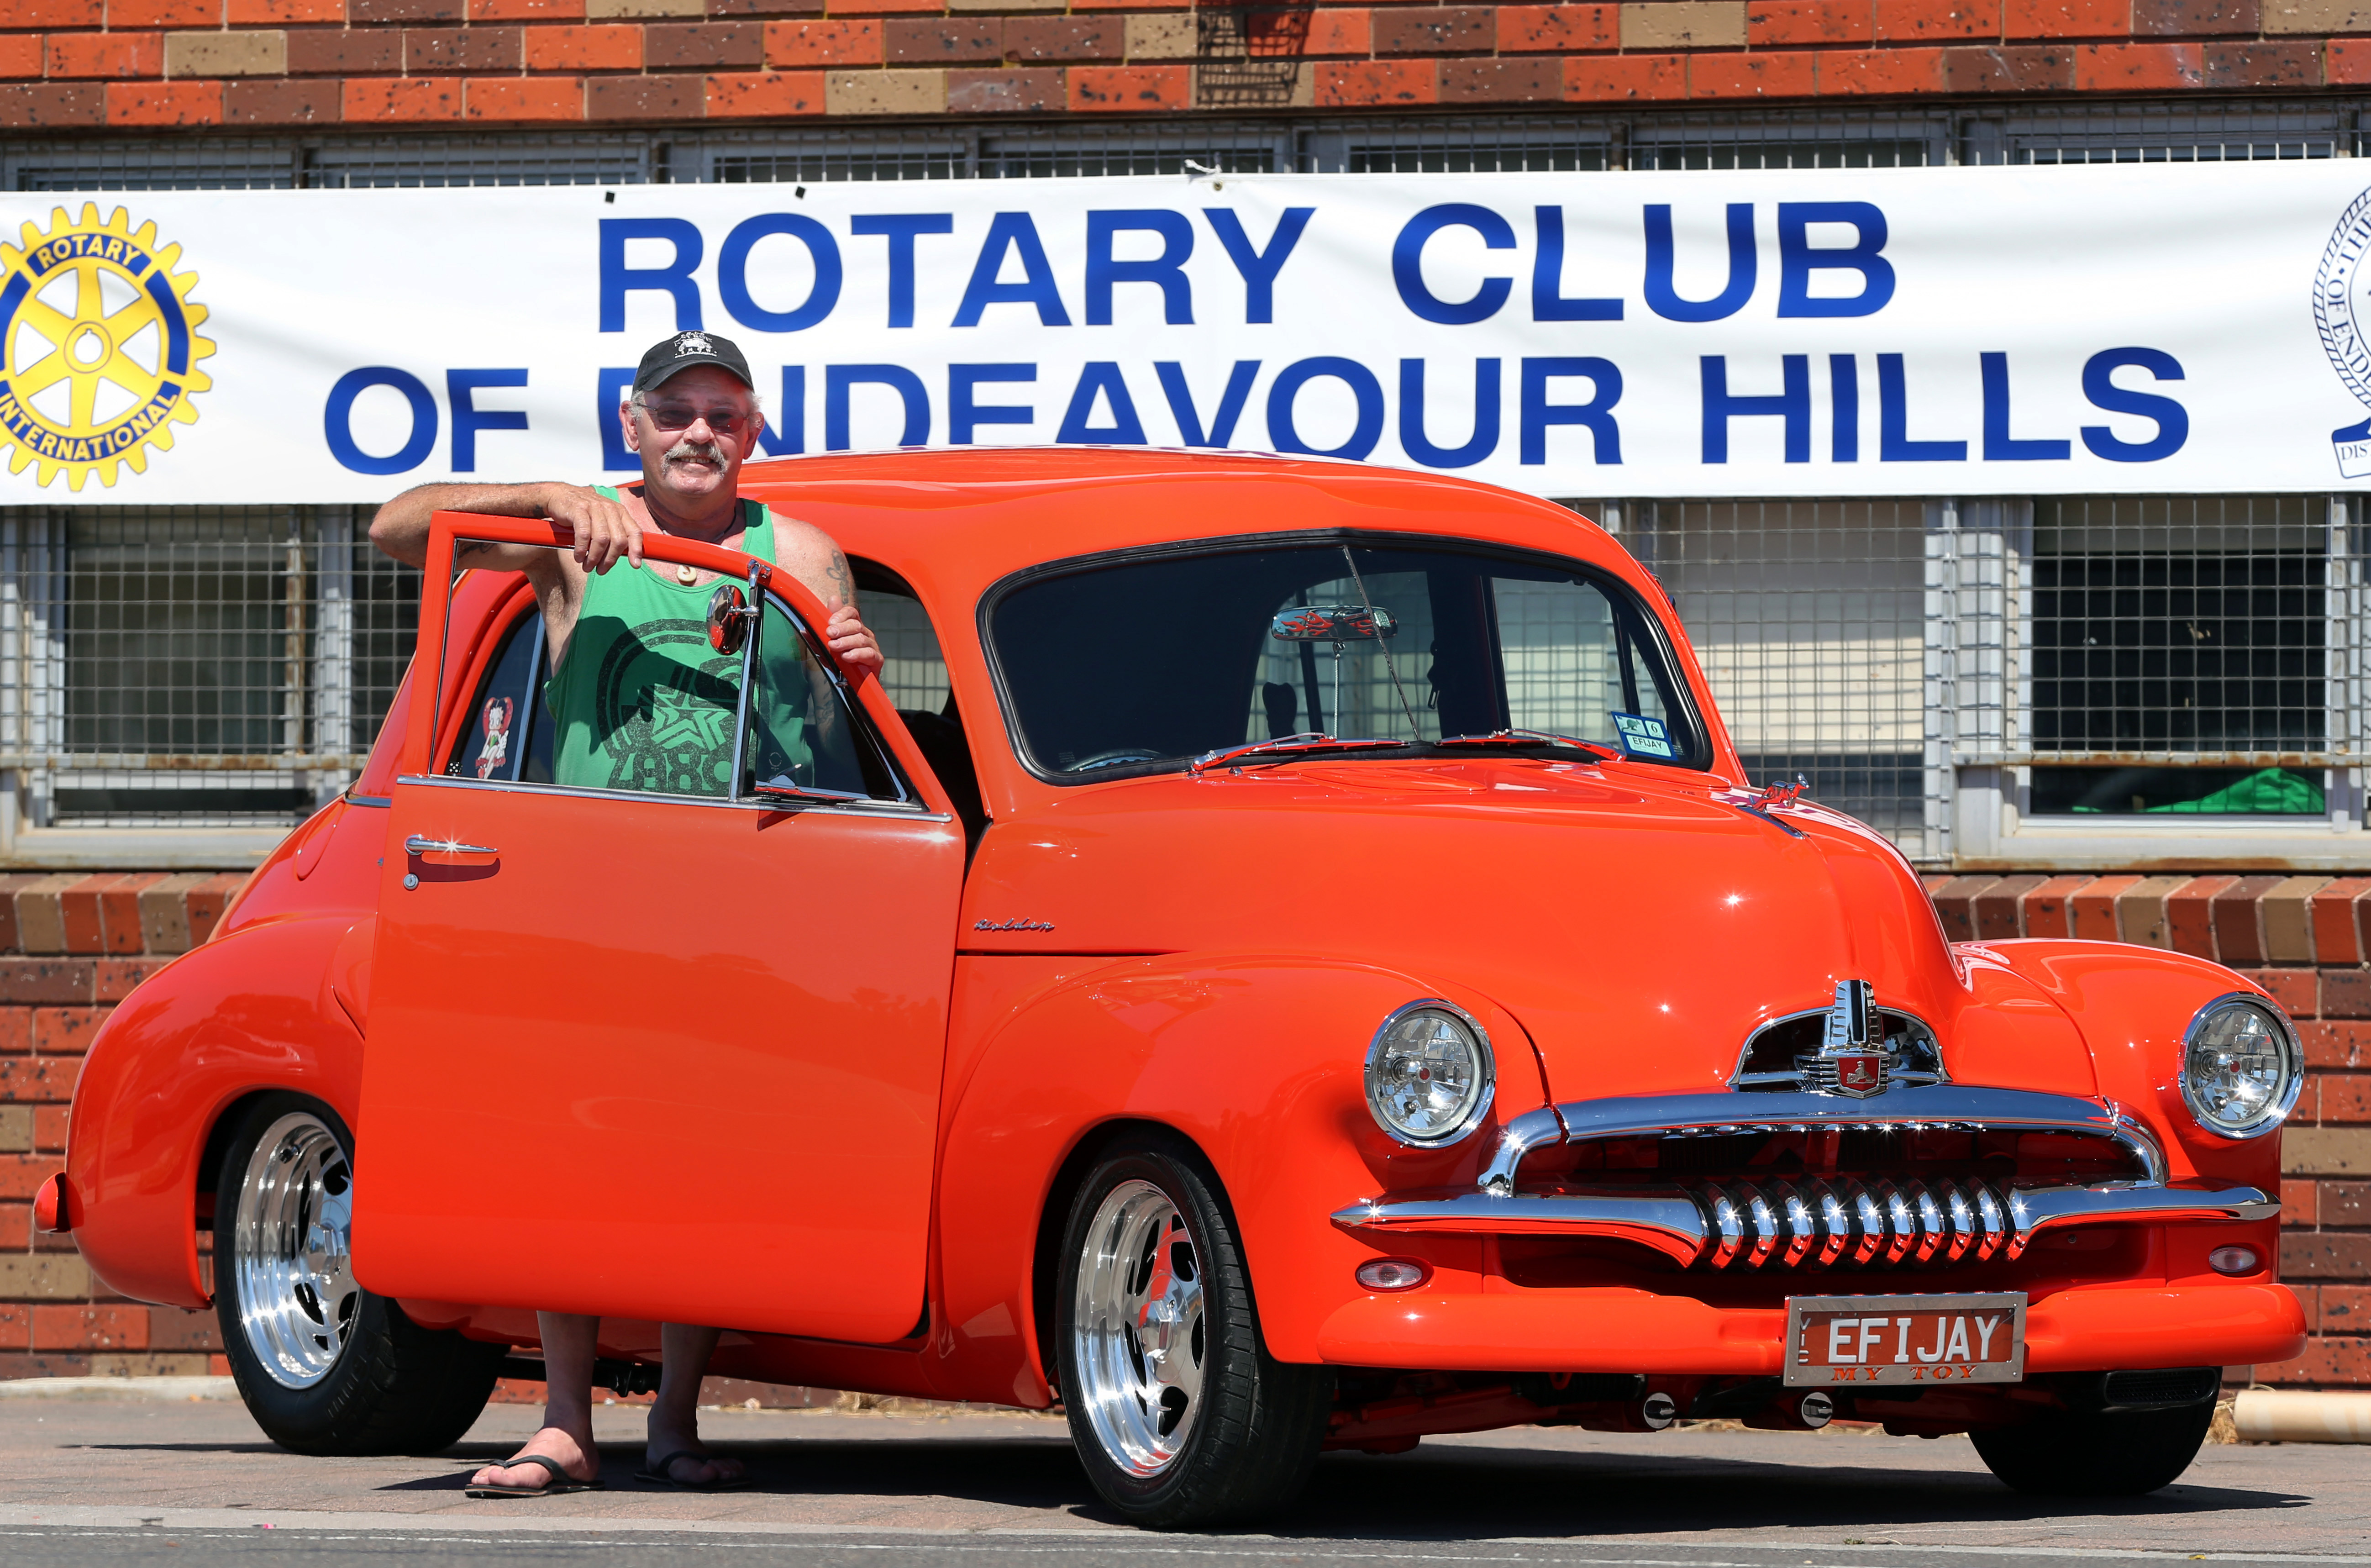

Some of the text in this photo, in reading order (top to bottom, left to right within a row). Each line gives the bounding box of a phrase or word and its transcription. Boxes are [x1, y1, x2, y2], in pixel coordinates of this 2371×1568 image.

[36, 234, 142, 271] ROTARY
[599, 201, 1896, 333] ROTARY CLUB
[2327, 279, 2347, 313] OF
[0, 392, 178, 461] INTERNATIONAL
[325, 367, 528, 475] OF
[1701, 347, 2189, 463] HILLS
[2340, 442, 2371, 461] DIS
[1632, 737, 1662, 749] EFIJAY
[1651, 723, 1658, 733] 6
[1829, 1315, 2000, 1363] EFIJAY
[1830, 1365, 1977, 1381] MY TOY
